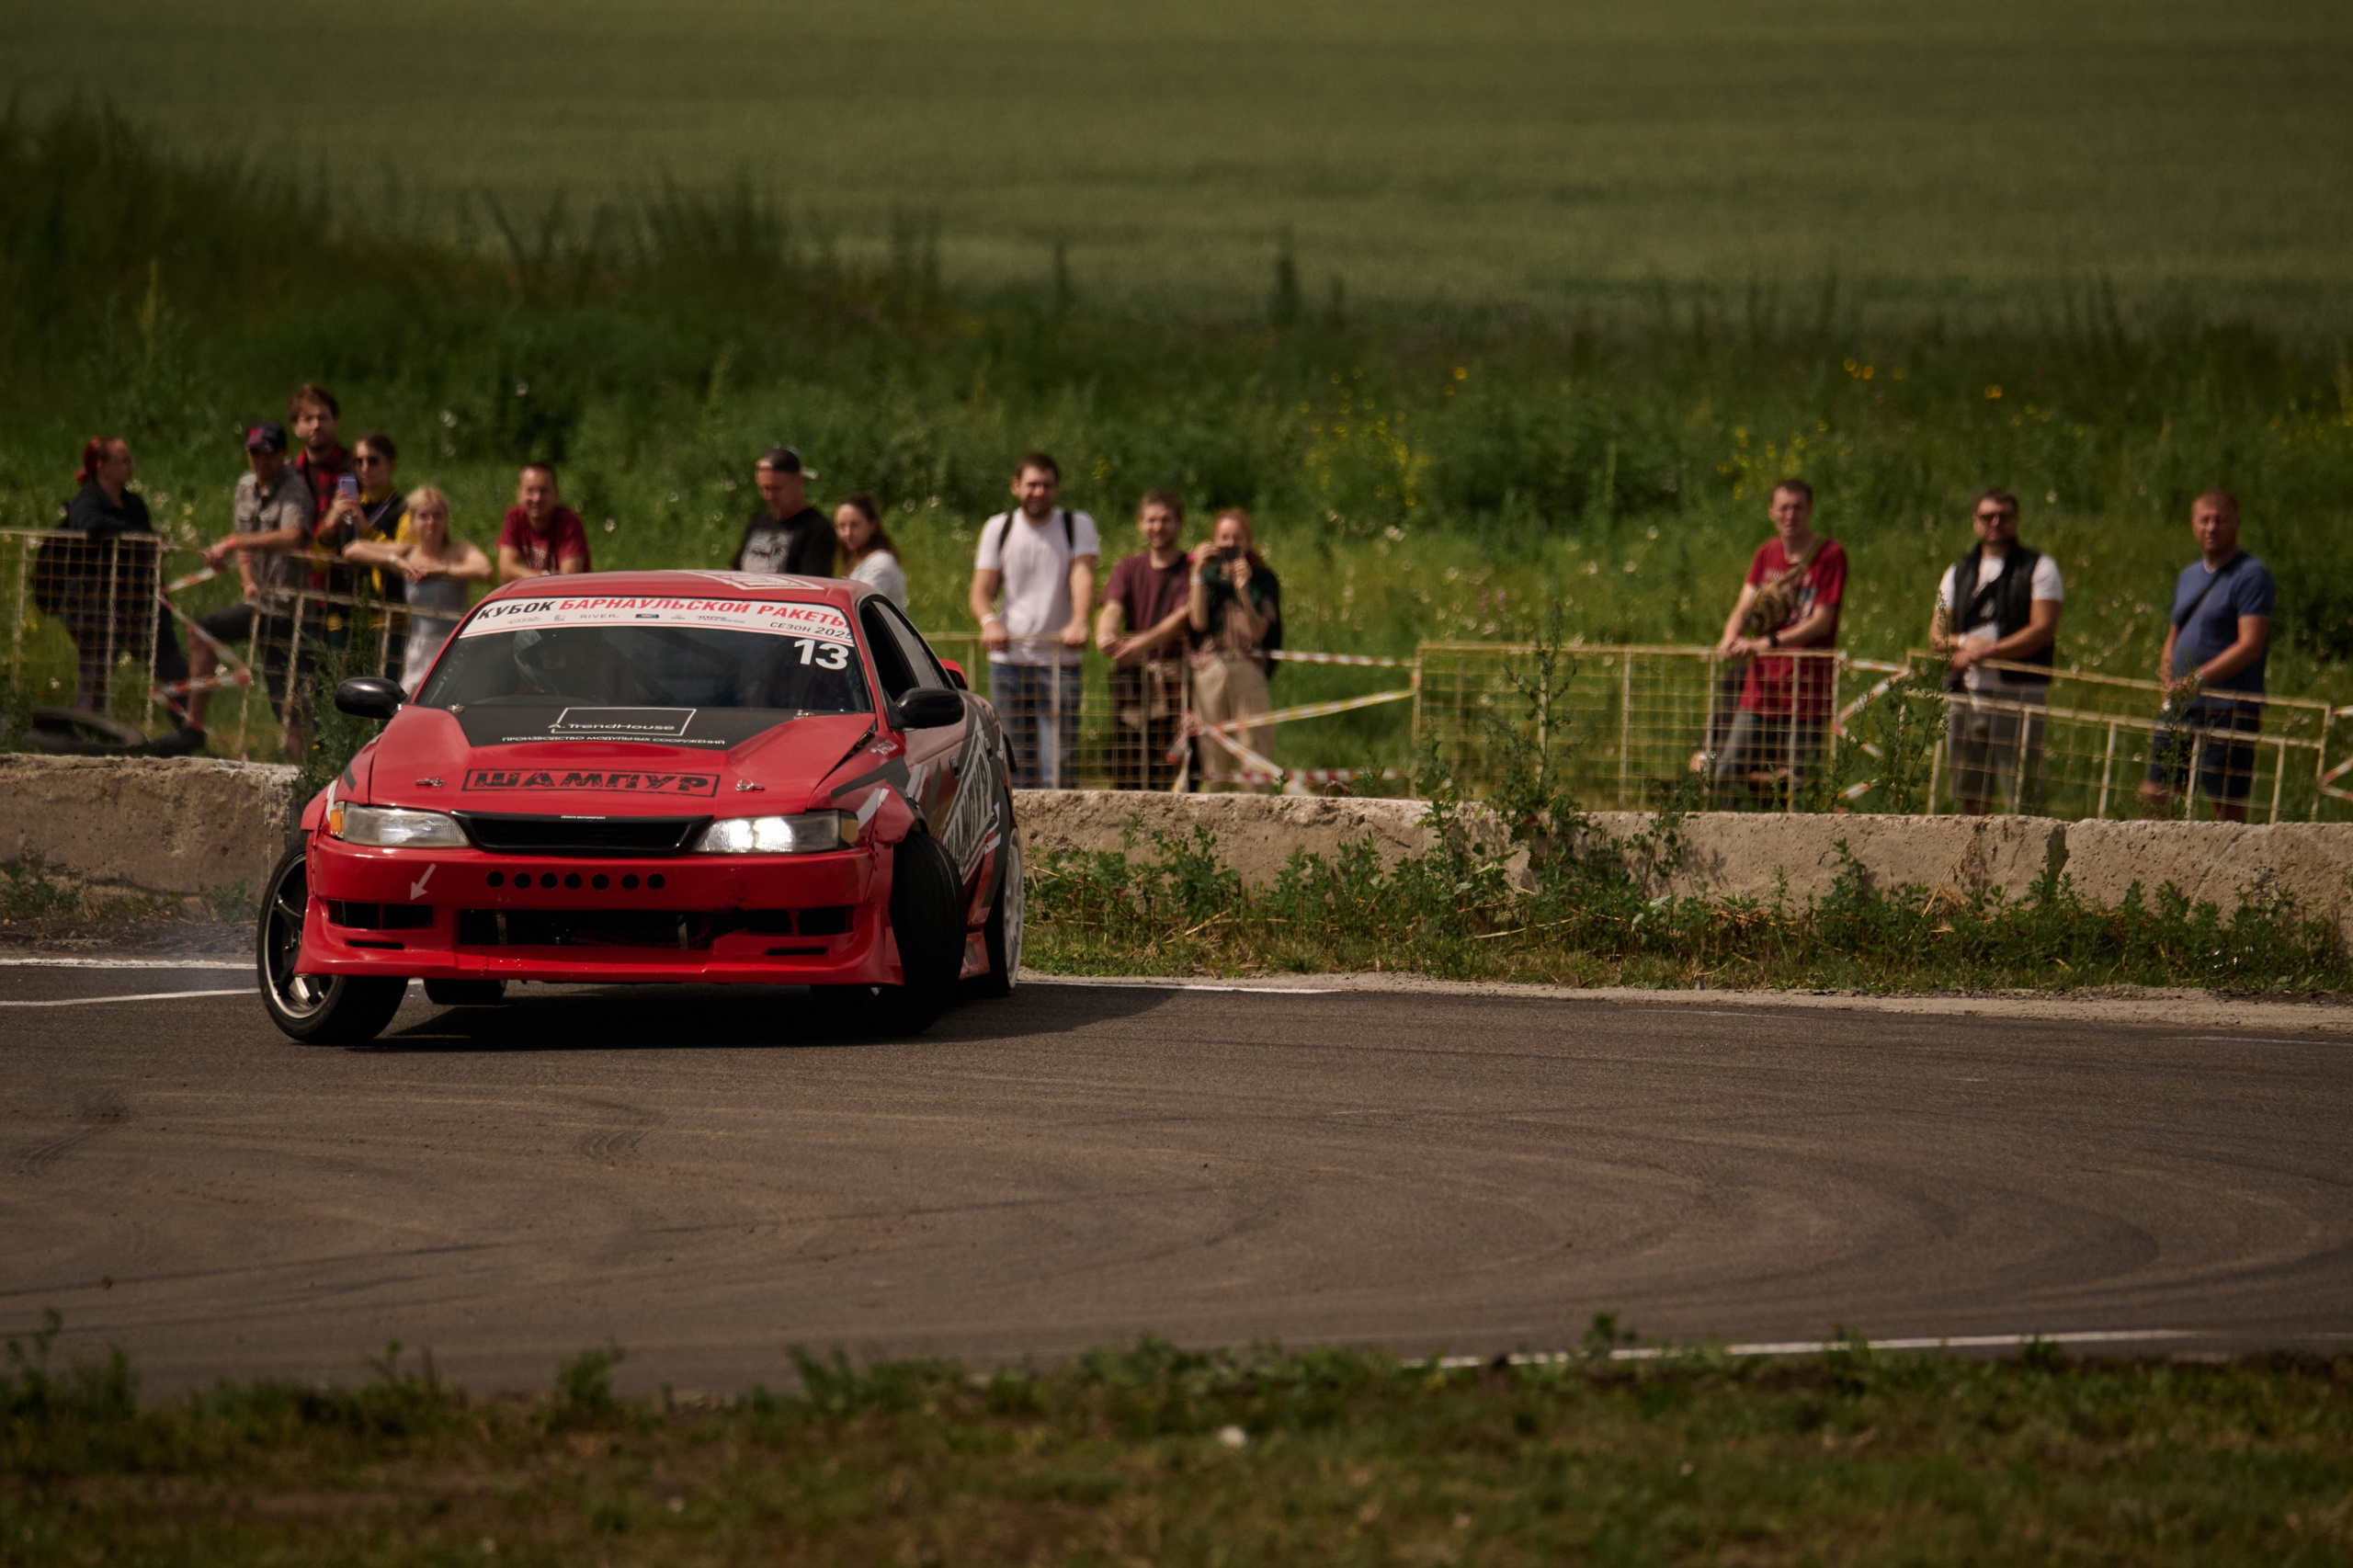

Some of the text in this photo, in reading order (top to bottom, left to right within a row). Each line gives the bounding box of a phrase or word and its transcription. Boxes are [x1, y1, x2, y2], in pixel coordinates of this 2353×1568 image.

[477, 600, 556, 620] КУБОК
[559, 598, 752, 613] БАРНАУЛЬСКОЙ
[769, 621, 853, 640] СЕЗОН 2025
[793, 638, 849, 670] 13
[653, 737, 726, 745] СООРУЖЕНИЙ
[473, 772, 709, 791] ШАМПУР
